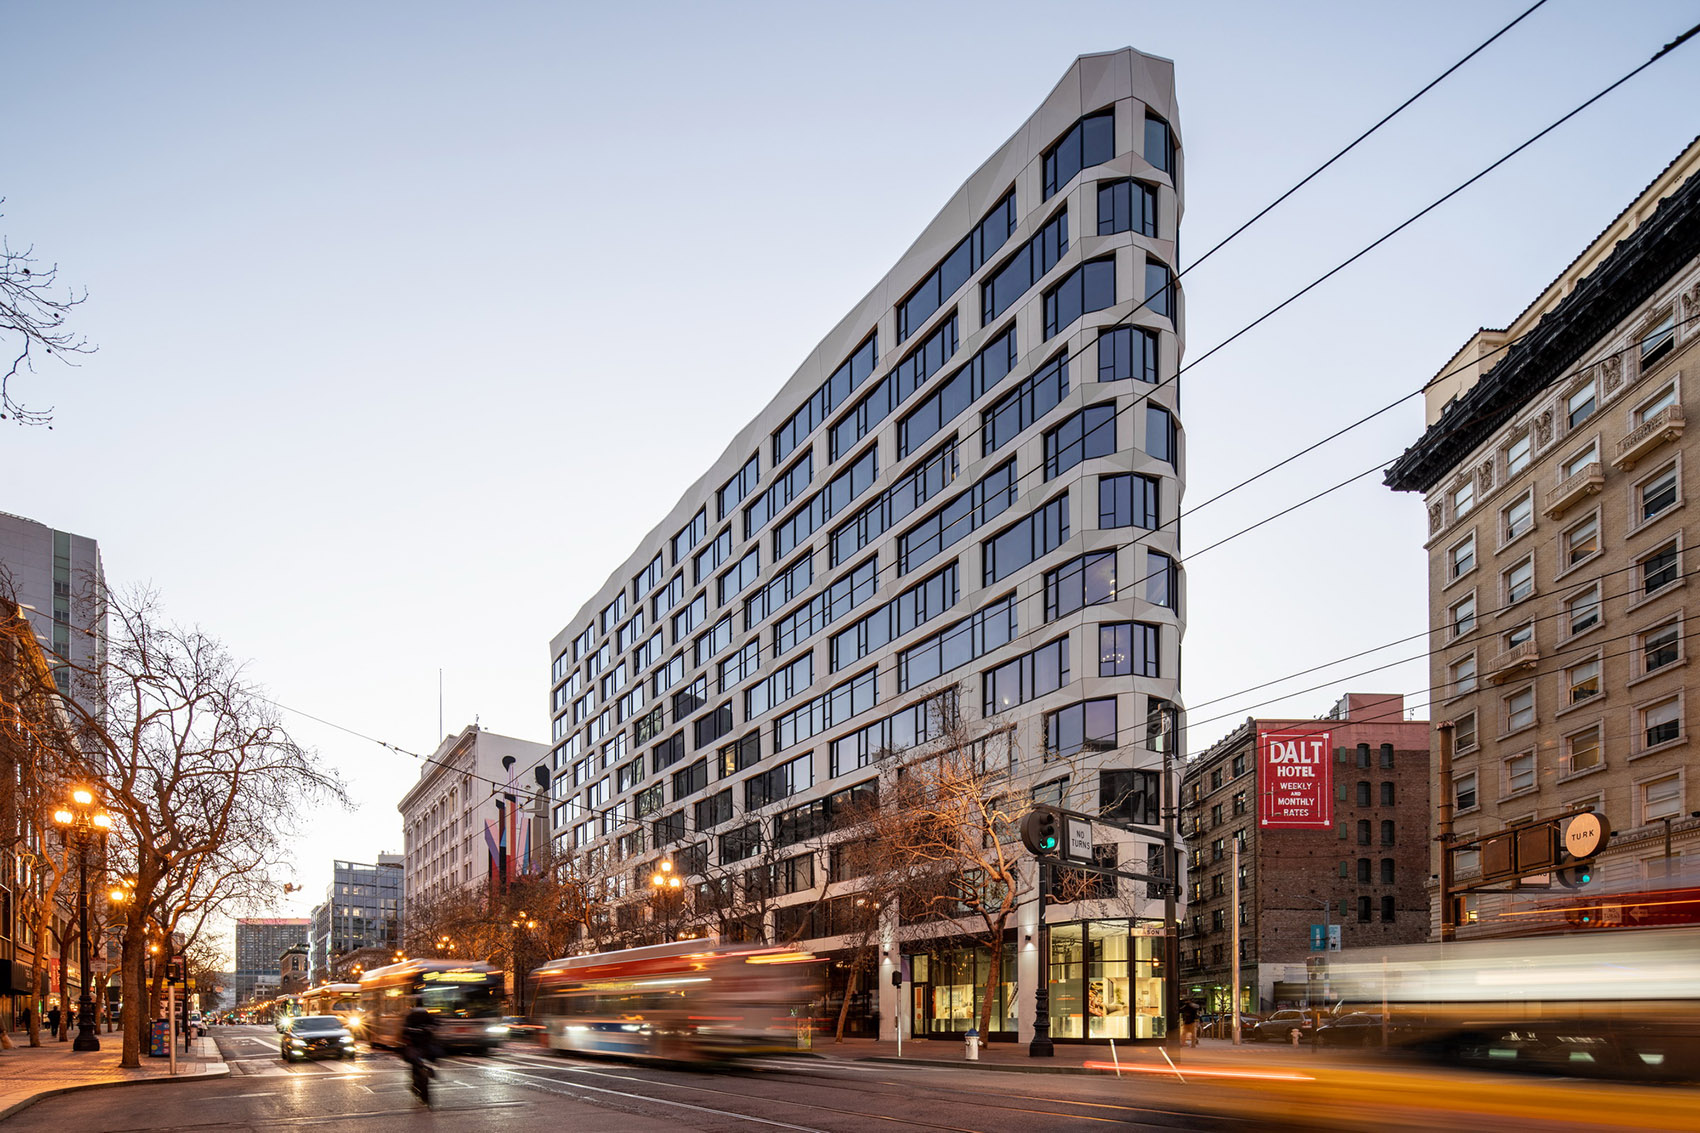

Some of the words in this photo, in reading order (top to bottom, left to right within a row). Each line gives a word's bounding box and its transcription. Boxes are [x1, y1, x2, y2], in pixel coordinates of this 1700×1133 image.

[1269, 741, 1323, 764] DALT
[1277, 766, 1315, 777] HOTEL
[1280, 782, 1312, 790] WEEKLY
[1278, 797, 1315, 806] MONTHLY
[1283, 808, 1309, 817] RATES
[1076, 830, 1085, 839] NO
[1571, 829, 1595, 841] TURK
[1071, 838, 1091, 850] TURNS
